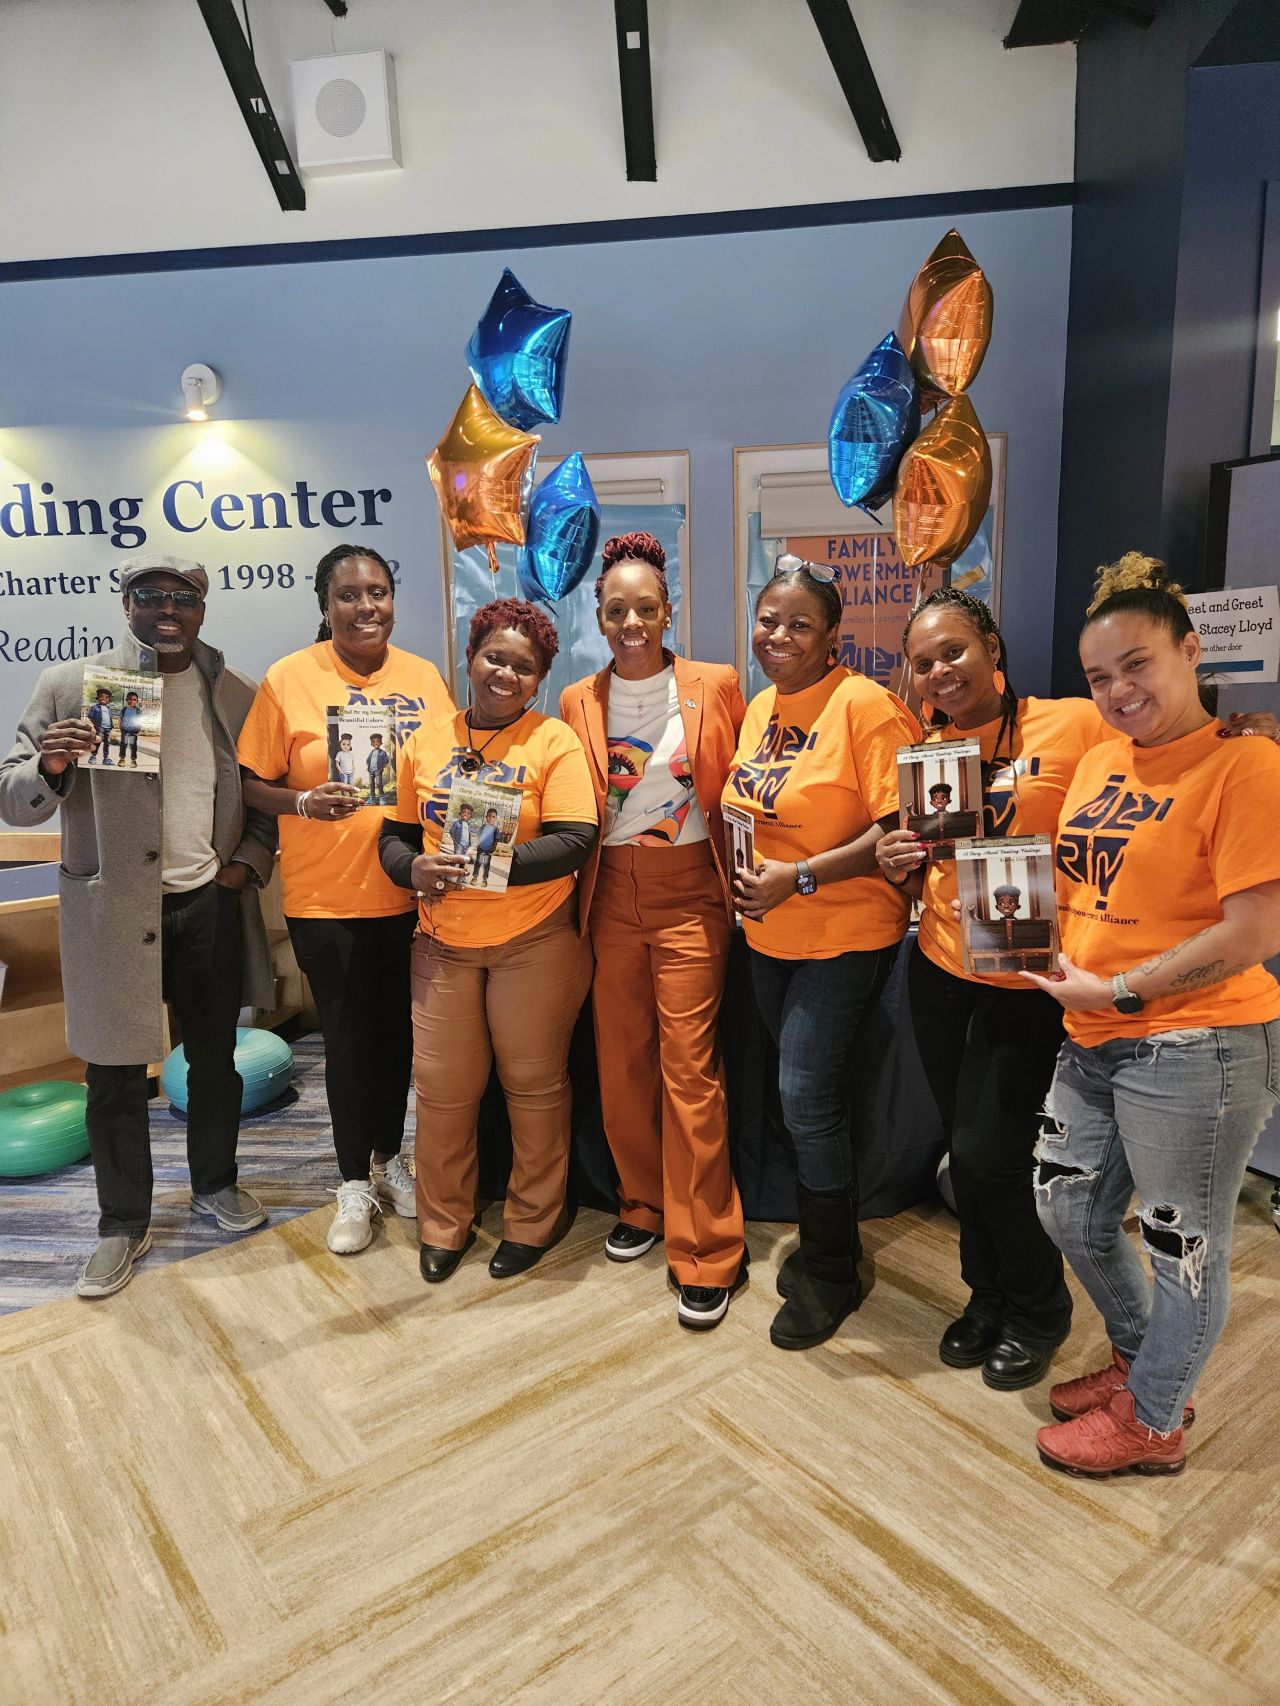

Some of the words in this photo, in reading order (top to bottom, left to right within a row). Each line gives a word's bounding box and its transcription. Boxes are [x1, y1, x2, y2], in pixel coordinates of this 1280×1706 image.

[0, 482, 147, 549] ding
[163, 480, 392, 533] Center
[828, 536, 897, 559] FAMILY
[218, 563, 295, 590] 1998
[1209, 599, 1230, 613] and
[1231, 596, 1264, 611] Greet
[1199, 623, 1237, 637] Stacey
[1239, 618, 1273, 635] Lloyd
[0, 626, 114, 662] Readin
[1209, 644, 1227, 653] other
[1228, 643, 1243, 652] door
